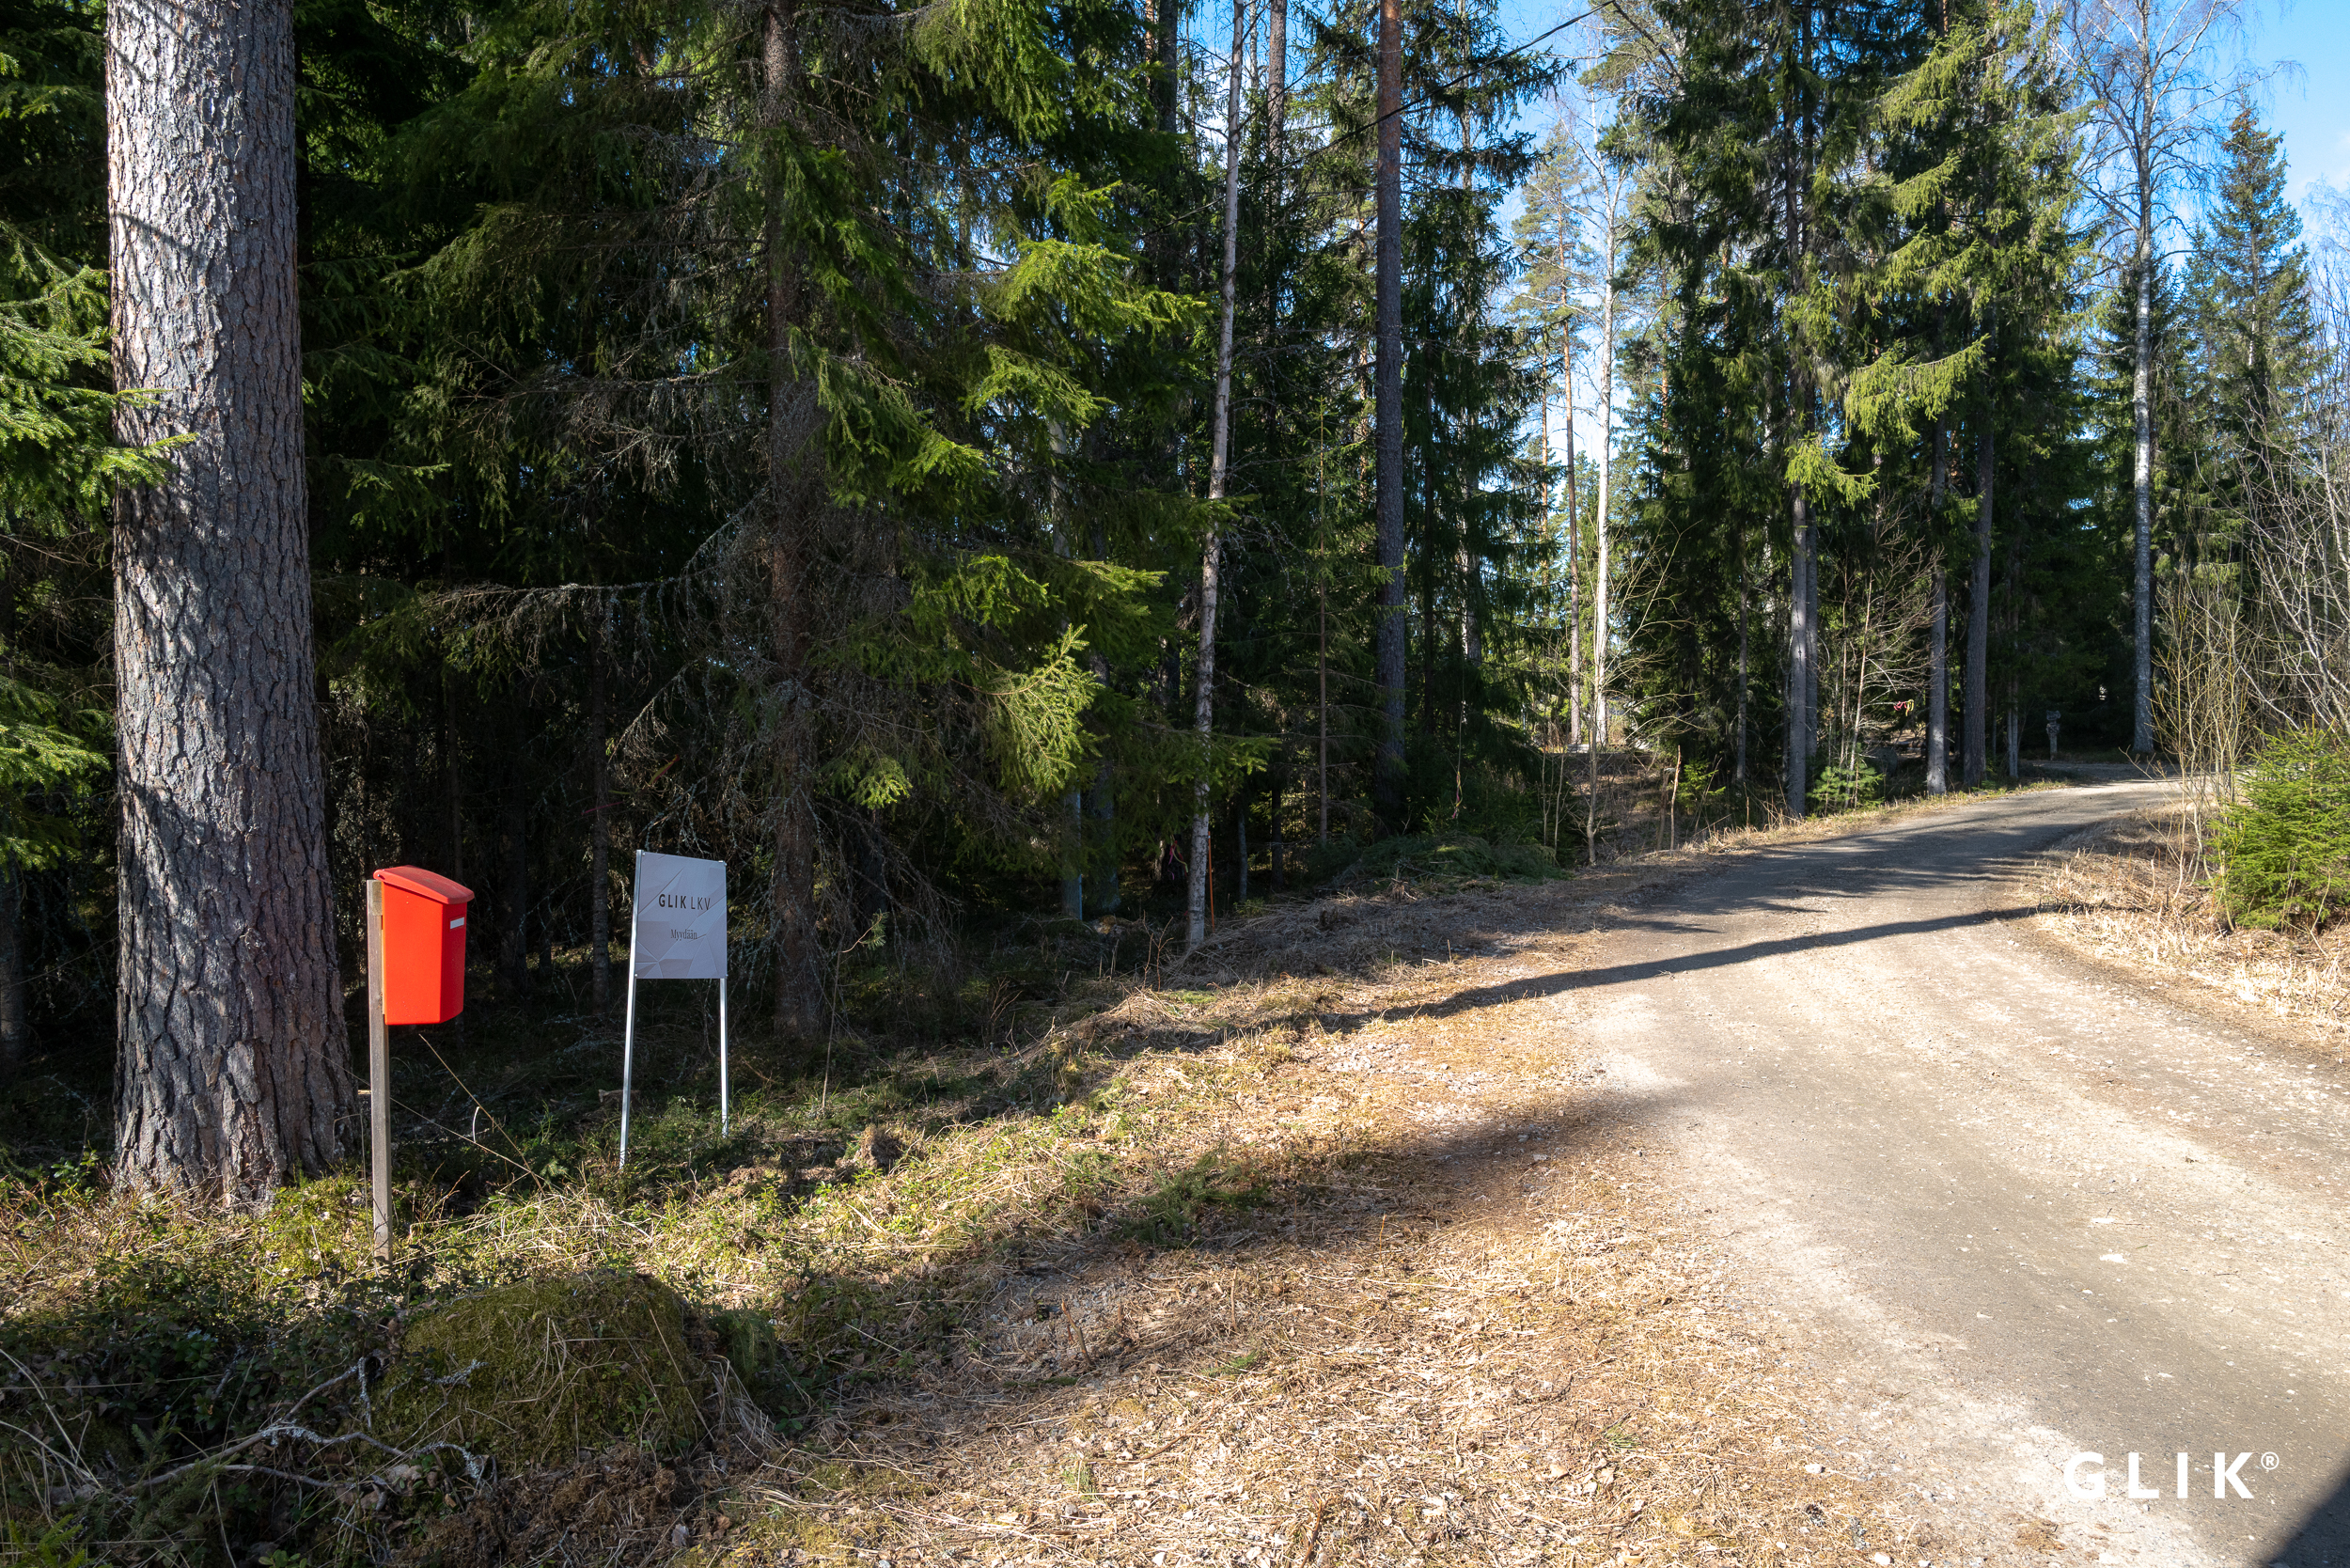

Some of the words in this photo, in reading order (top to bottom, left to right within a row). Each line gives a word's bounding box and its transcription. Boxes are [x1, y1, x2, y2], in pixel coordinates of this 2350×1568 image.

[658, 894, 687, 909] GLIK
[690, 896, 711, 910] LKV
[670, 929, 697, 941] Myydään
